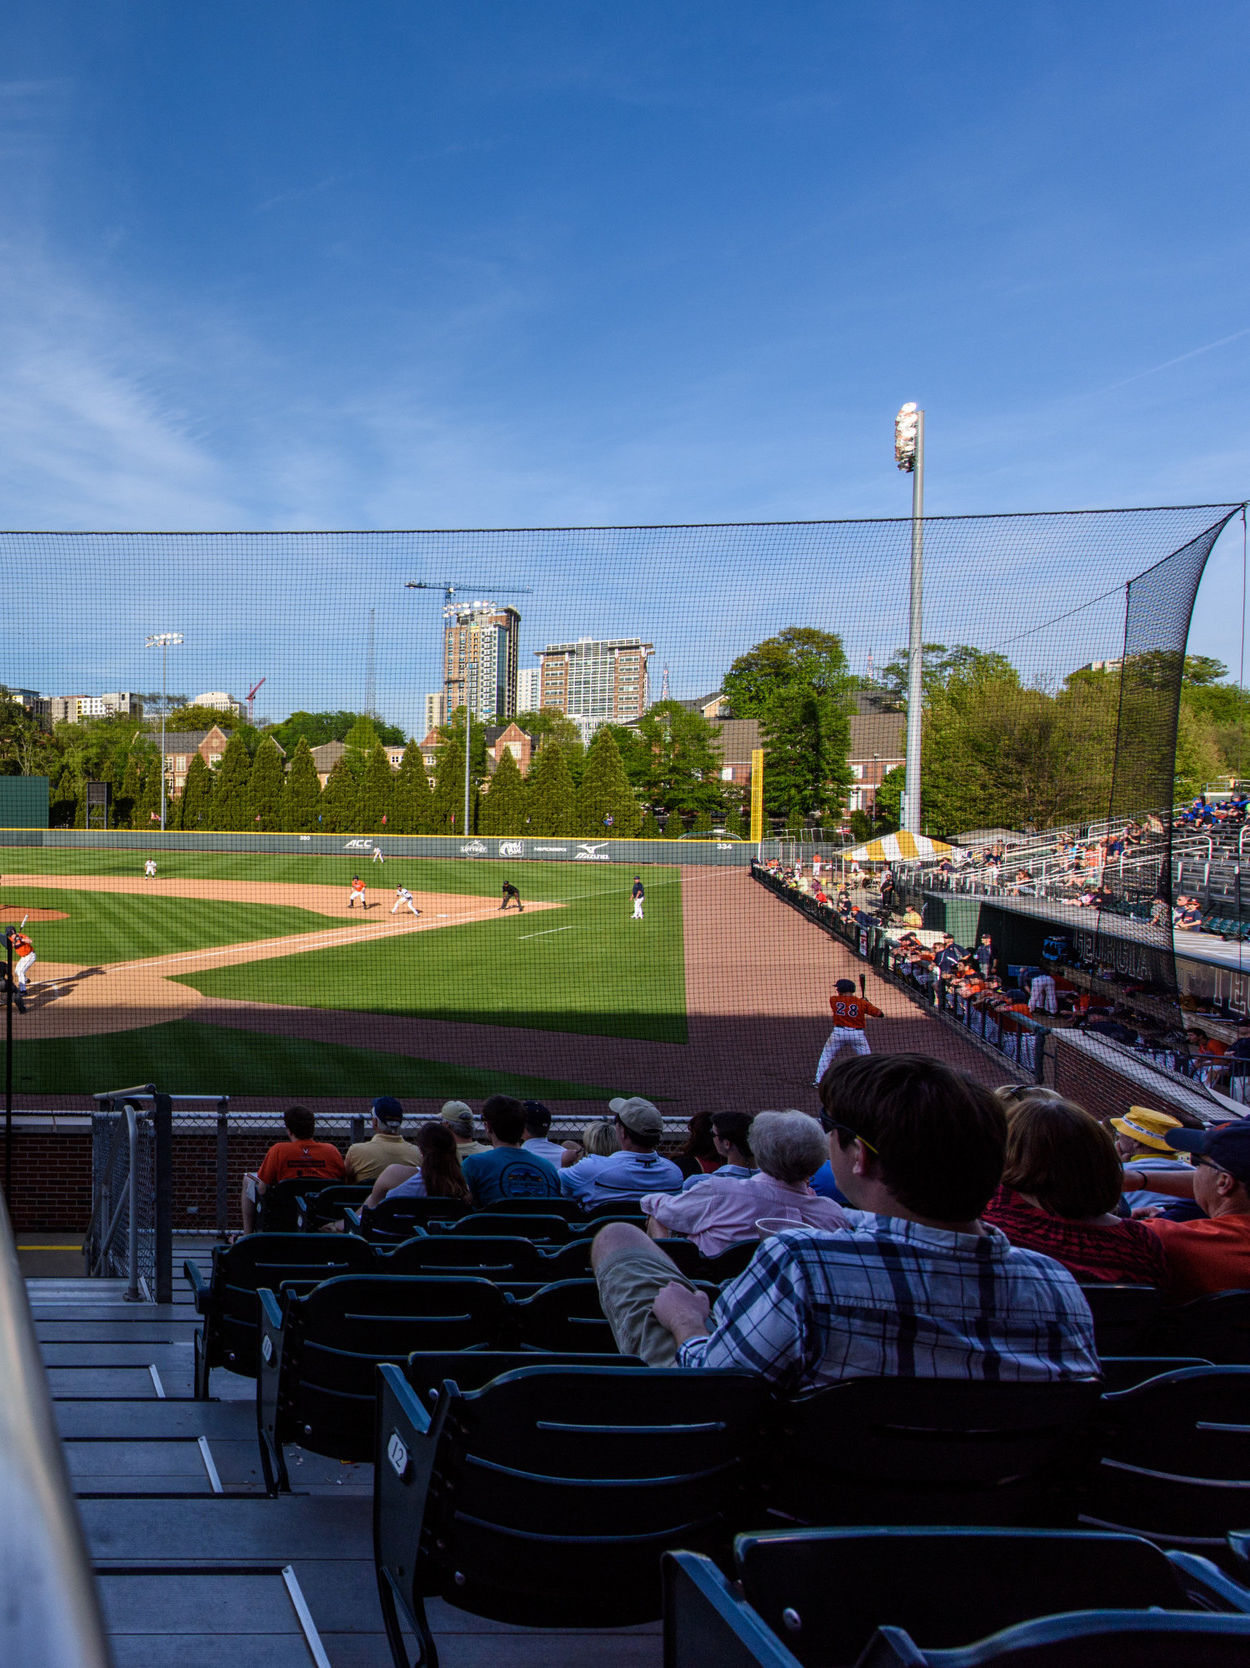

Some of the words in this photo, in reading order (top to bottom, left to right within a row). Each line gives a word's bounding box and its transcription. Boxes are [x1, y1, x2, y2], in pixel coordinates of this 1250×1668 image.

[344, 840, 373, 848] ACC
[836, 1002, 859, 1018] 28
[392, 1442, 403, 1468] 12
